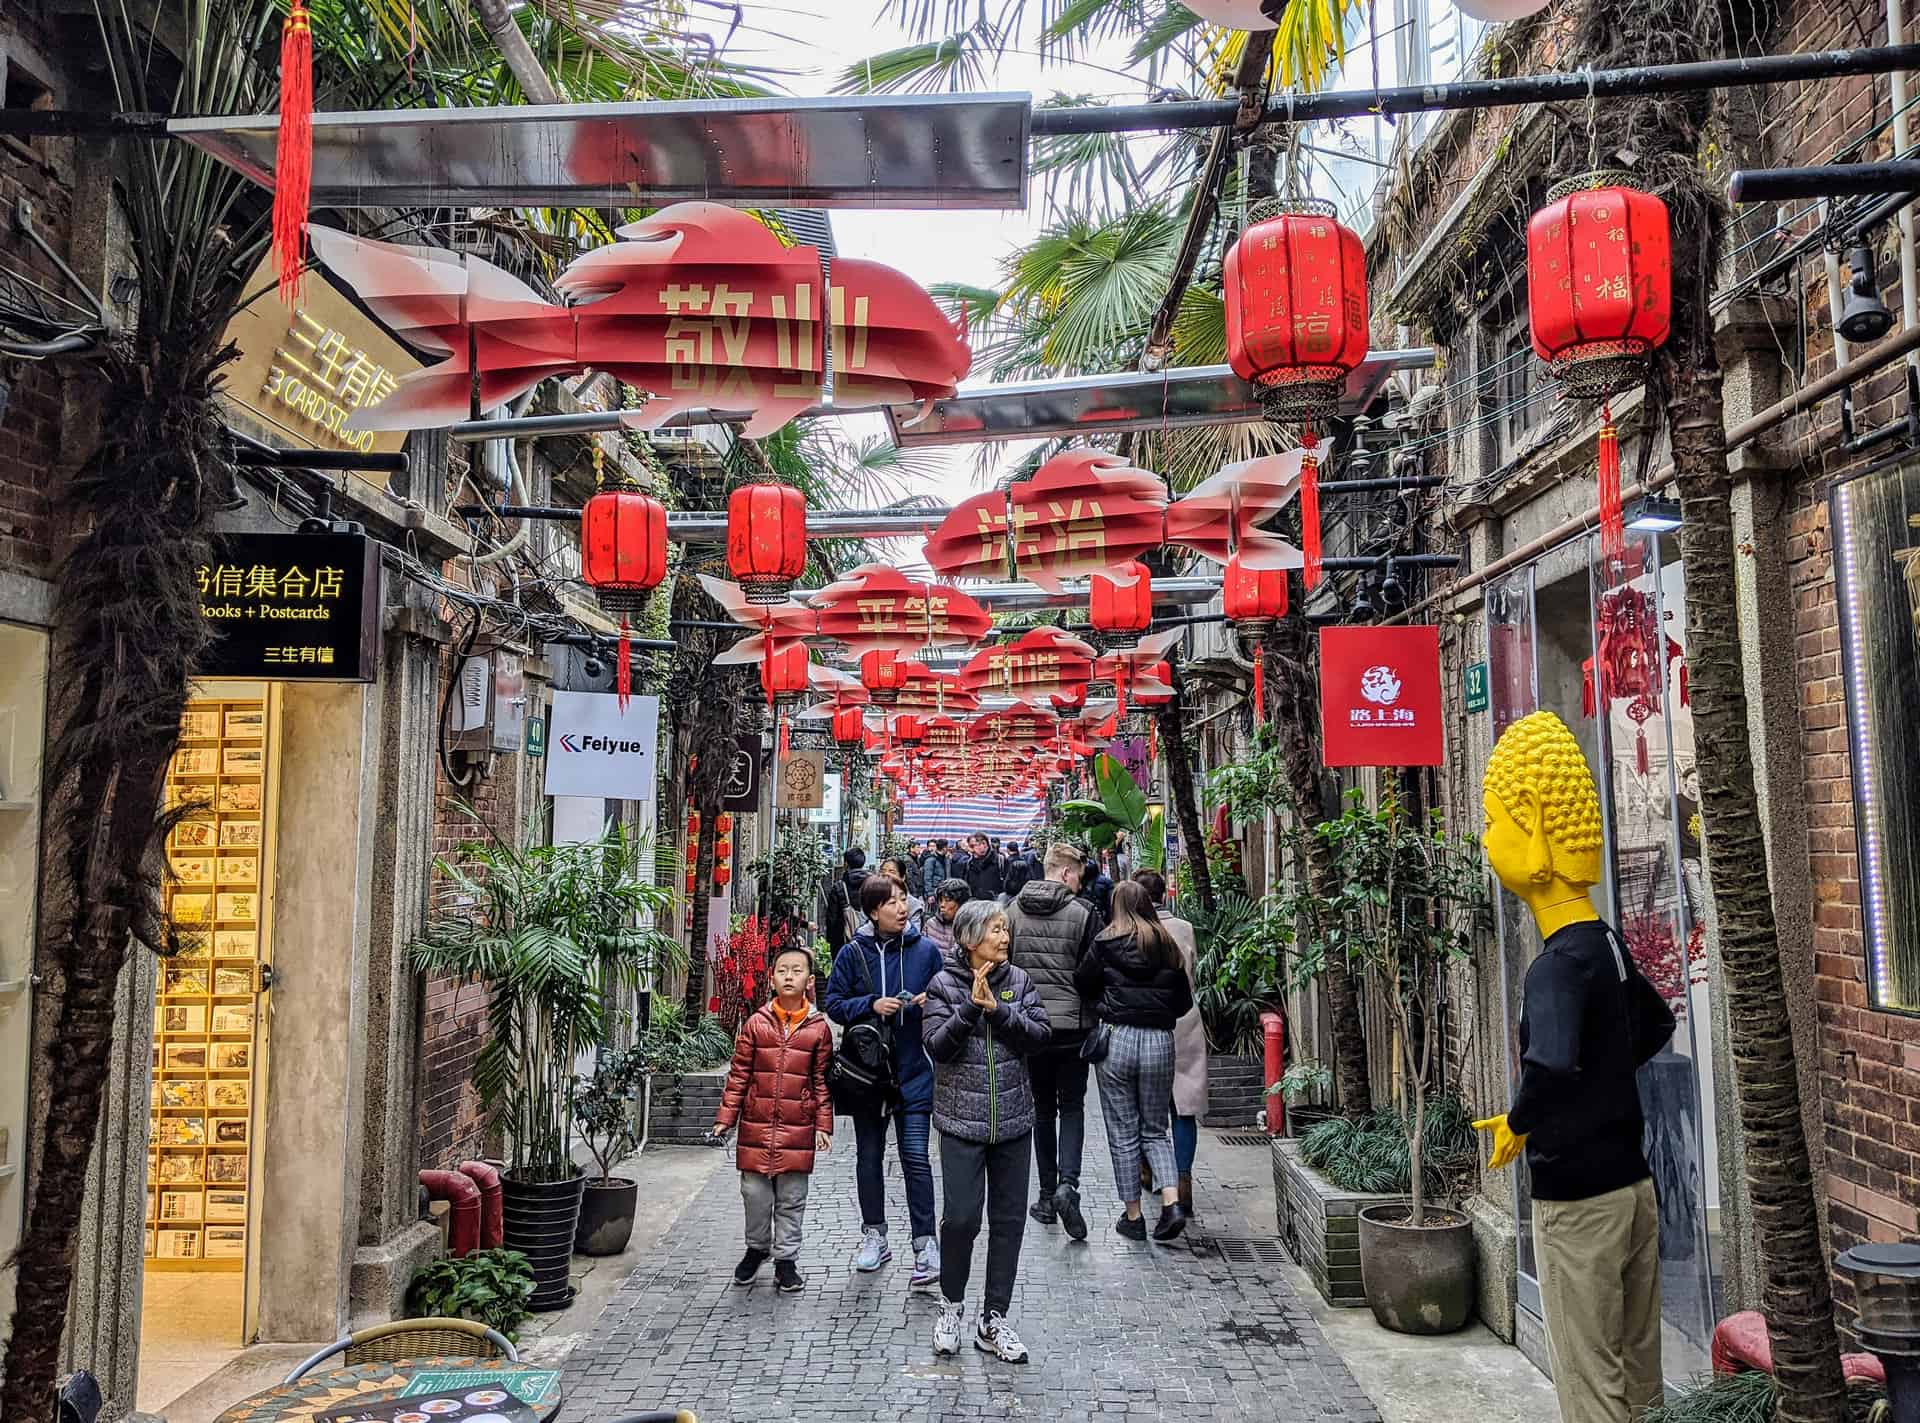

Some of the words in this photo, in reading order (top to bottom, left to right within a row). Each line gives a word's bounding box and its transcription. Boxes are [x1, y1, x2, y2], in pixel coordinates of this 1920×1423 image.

[1596, 274, 1628, 301] 福
[659, 283, 913, 402] 敬业
[1293, 311, 1332, 352] 福
[264, 367, 285, 396] 3
[285, 377, 328, 422] CARD
[975, 499, 1106, 574] 法治
[244, 605, 256, 618] +
[260, 603, 330, 619] Postcards
[857, 596, 950, 638] 平等
[263, 646, 335, 664] 三生有信
[987, 653, 1061, 688] 和谐
[1470, 669, 1482, 695] 32
[582, 735, 645, 756] Feiyue.
